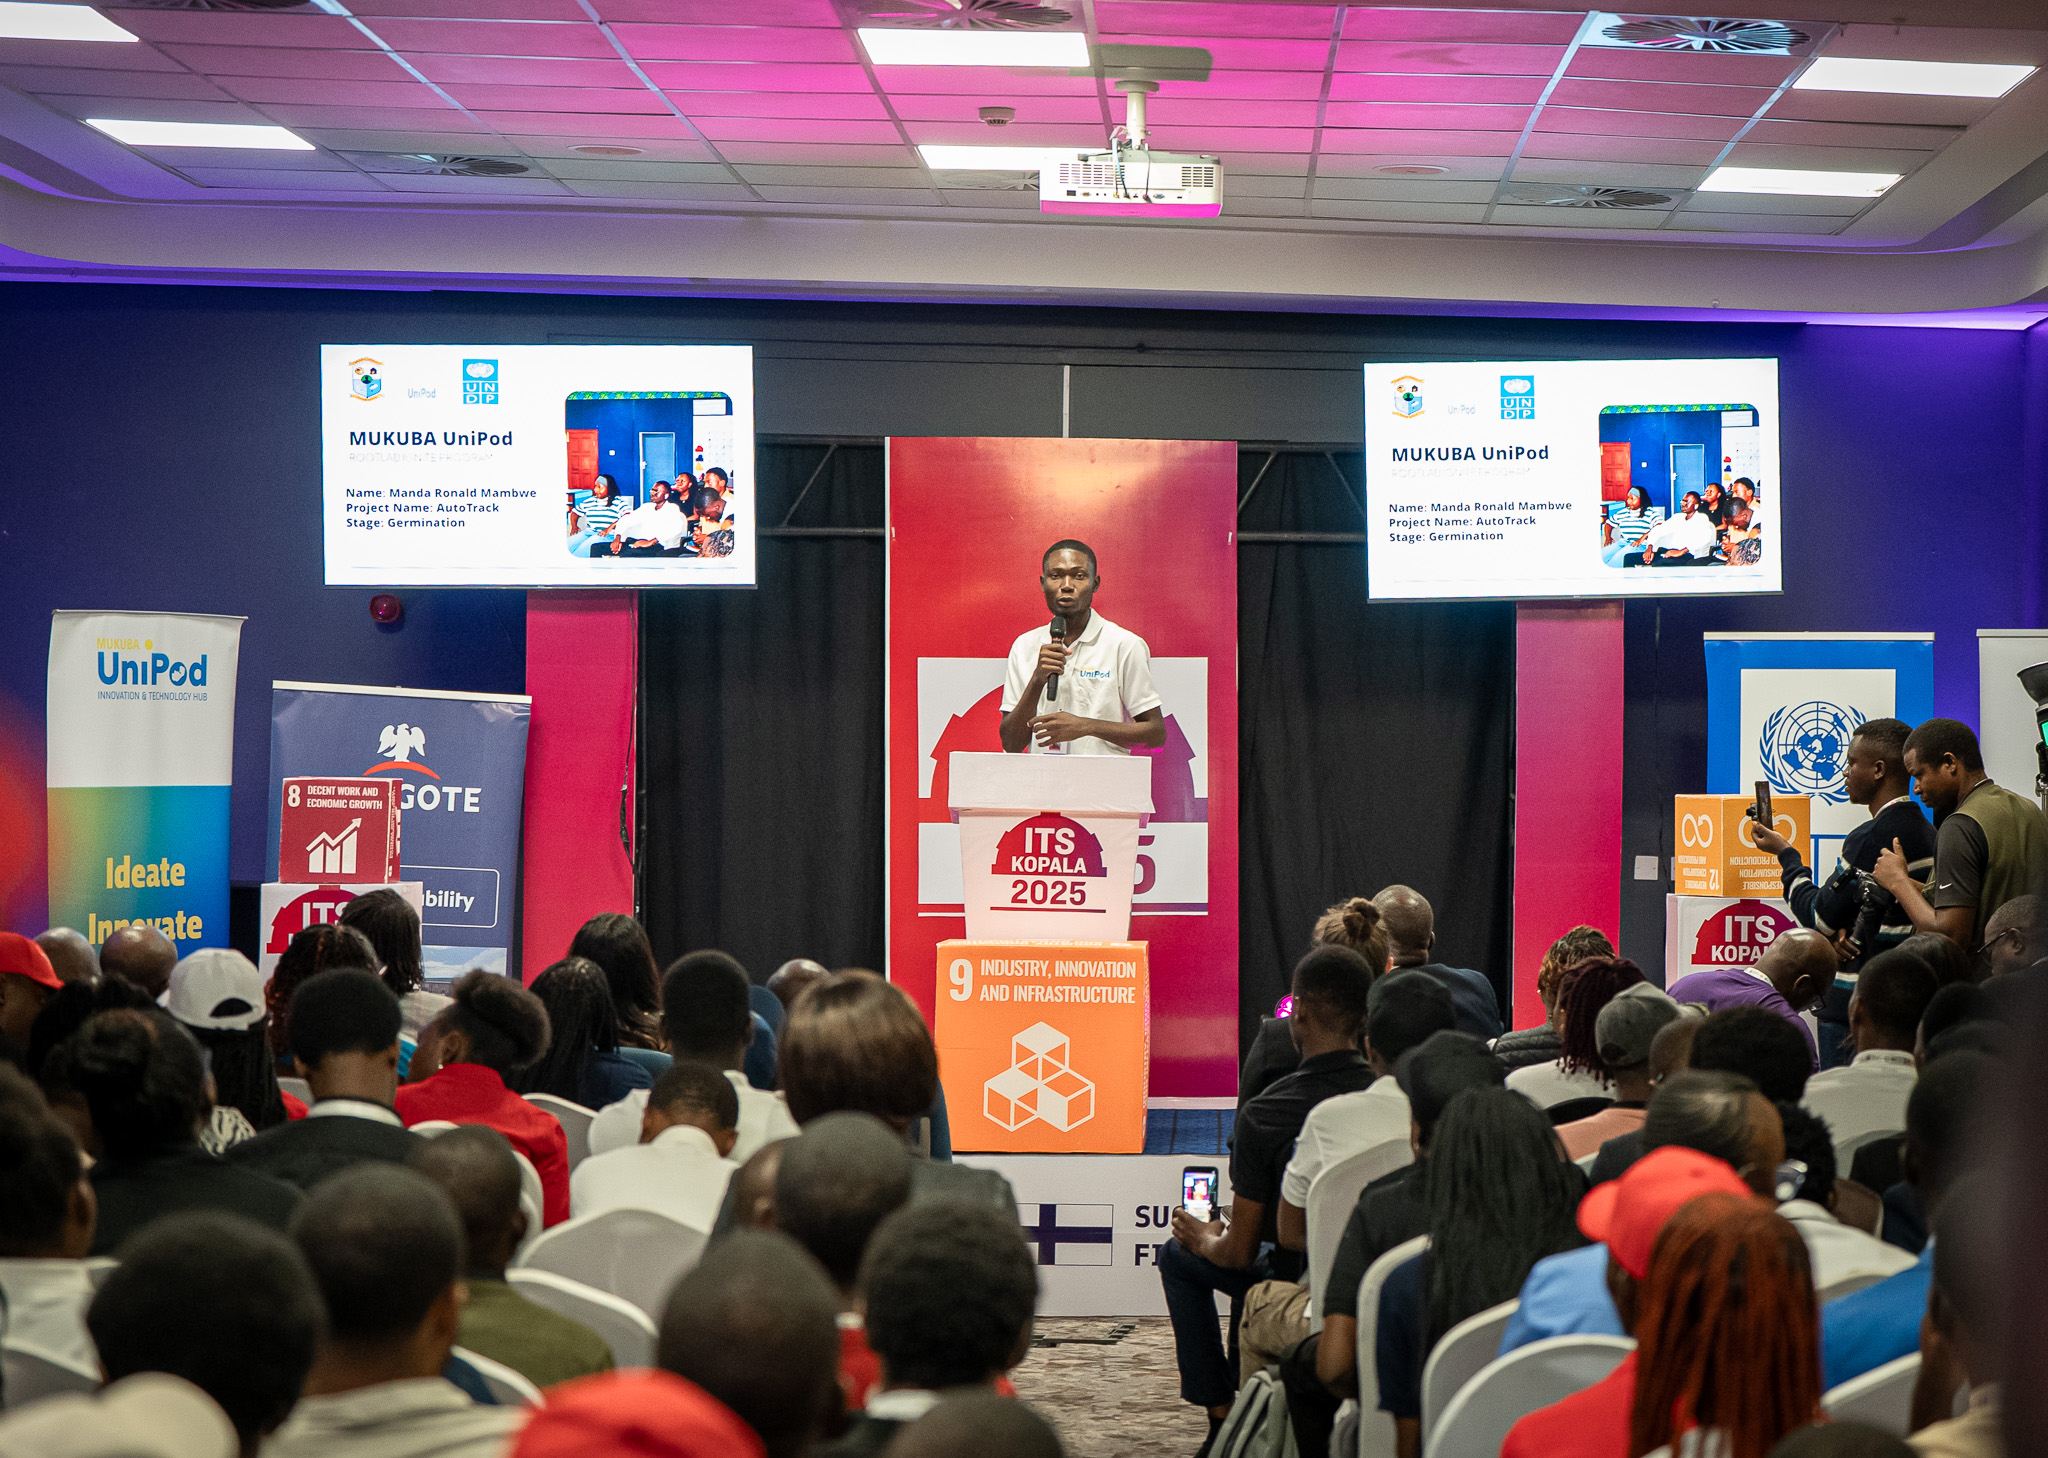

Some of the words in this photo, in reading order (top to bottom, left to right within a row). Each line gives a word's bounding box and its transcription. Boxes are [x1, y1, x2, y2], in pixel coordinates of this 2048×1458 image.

[350, 431, 437, 446] MUKUBA
[443, 430, 513, 446] UniPod
[1392, 447, 1476, 462] MUKUBA
[1482, 445, 1549, 460] UniPod
[346, 488, 386, 498] Name:
[389, 488, 431, 498] Manda
[435, 488, 477, 498] Ronald
[481, 488, 537, 498] Mambwe
[346, 503, 389, 515] Project
[393, 503, 433, 513] Name:
[437, 503, 500, 513] AutoTrack
[1389, 503, 1427, 513] Name:
[1431, 503, 1471, 512] Manda
[1474, 502, 1515, 512] Ronald
[1518, 501, 1572, 511] Mambwe
[346, 518, 385, 530] Stage:
[388, 517, 466, 528] Germination
[1389, 518, 1431, 530] Project
[1434, 517, 1473, 526] Name:
[1476, 516, 1537, 526] AutoTrack
[1389, 532, 1426, 545] Stage:
[1429, 531, 1504, 541] Germination
[96, 637, 140, 650] MUKUBA
[97, 651, 208, 687] UniPod
[1080, 670, 1110, 678] UniPod
[97, 690, 140, 700] INNOVATION
[142, 691, 147, 701] &
[149, 691, 191, 701] TECHNOLOGY
[193, 692, 208, 702] HUB
[287, 784, 301, 808] 8
[307, 785, 336, 796] DECENT
[337, 786, 361, 796] WORK
[361, 787, 379, 797] AND
[401, 784, 482, 813] GOTE
[306, 798, 348, 809] ECONOMIC
[349, 799, 383, 810] GROWTH
[1024, 827, 1075, 856] ITS
[106, 855, 186, 889] Ideate
[1011, 855, 1087, 874] KOPALA
[1709, 868, 1720, 890] 12
[422, 889, 475, 913] bility
[1010, 879, 1086, 906] 2025
[1724, 915, 1776, 944] ITS
[1711, 945, 1770, 962] KOPA
[980, 959, 1052, 980] INDUSTRY,
[1054, 960, 1136, 979] INNOVATION
[949, 958, 973, 1002] 9
[980, 984, 1009, 1002] AND
[1013, 984, 1136, 1004] INFRASTRUCTURE
